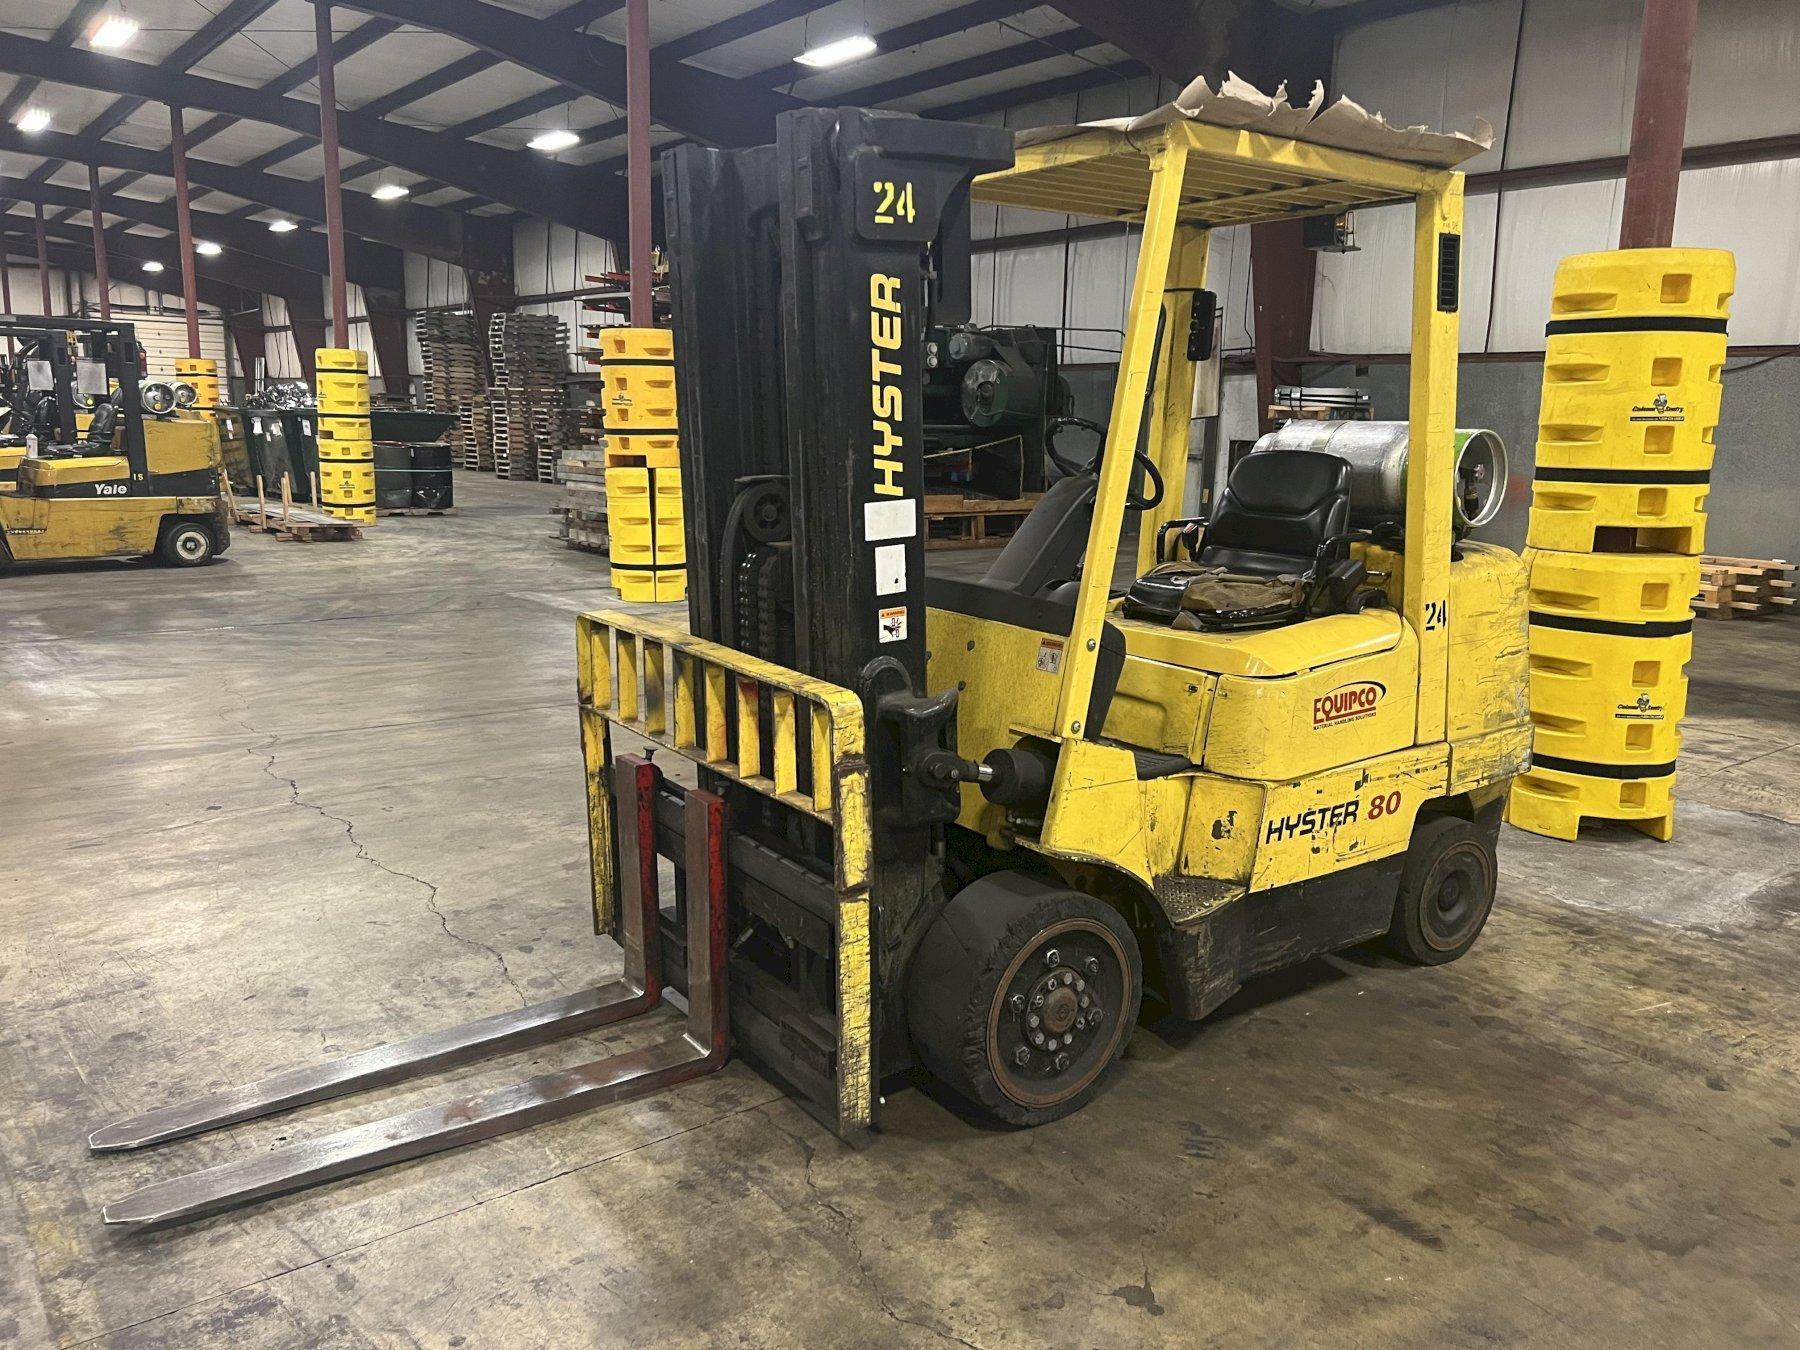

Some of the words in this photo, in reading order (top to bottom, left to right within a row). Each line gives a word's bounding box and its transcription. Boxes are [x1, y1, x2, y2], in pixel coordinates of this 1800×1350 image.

[873, 181, 916, 224] 24
[870, 273, 904, 497] HYSTER
[94, 483, 128, 495] Yale
[1425, 599, 1447, 631] 24
[1313, 686, 1377, 725] EQUIPCO
[1313, 722, 1333, 731] MATERIAL
[1334, 717, 1355, 727] HANDLING
[1355, 712, 1377, 721] SOLUTIONS
[1265, 799, 1360, 844] HYSTER
[1367, 790, 1402, 820] 80
